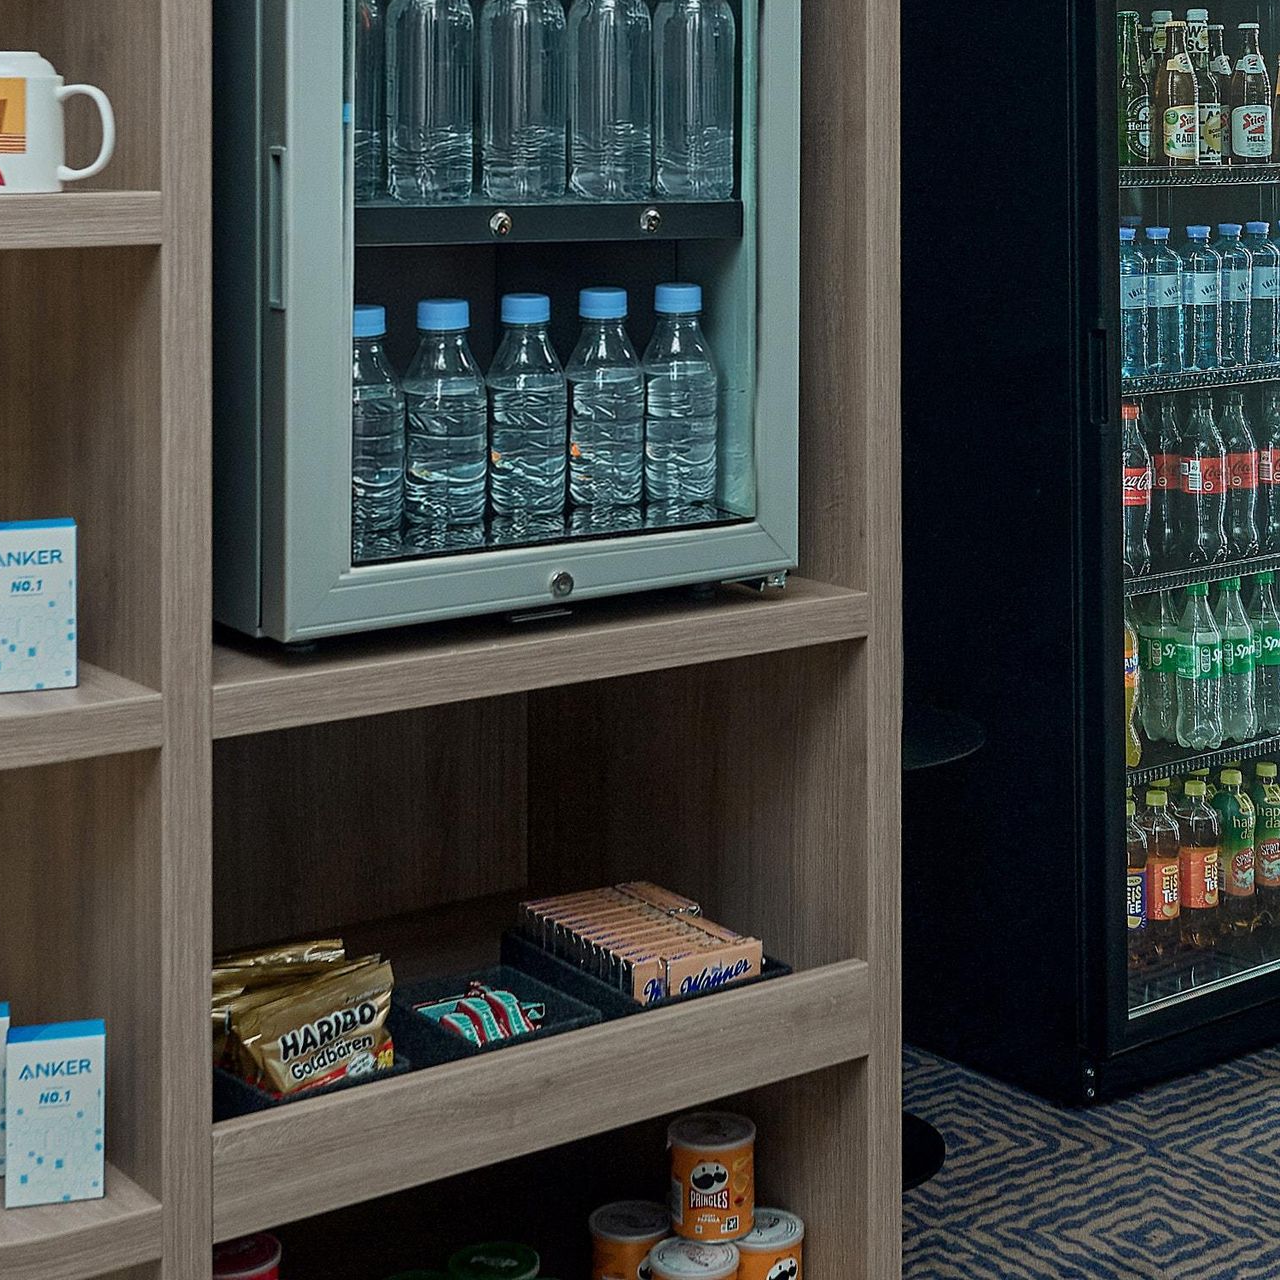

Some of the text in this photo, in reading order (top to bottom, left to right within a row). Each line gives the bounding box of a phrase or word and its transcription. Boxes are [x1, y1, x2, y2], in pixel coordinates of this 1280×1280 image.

[10, 580, 43, 593] NO.1
[280, 1002, 377, 1061] HARIBO
[291, 1035, 373, 1080] Goldbären
[18, 1058, 92, 1081] ANKER
[38, 1090, 71, 1104] NO.1
[690, 1189, 728, 1209] PRINGLES
